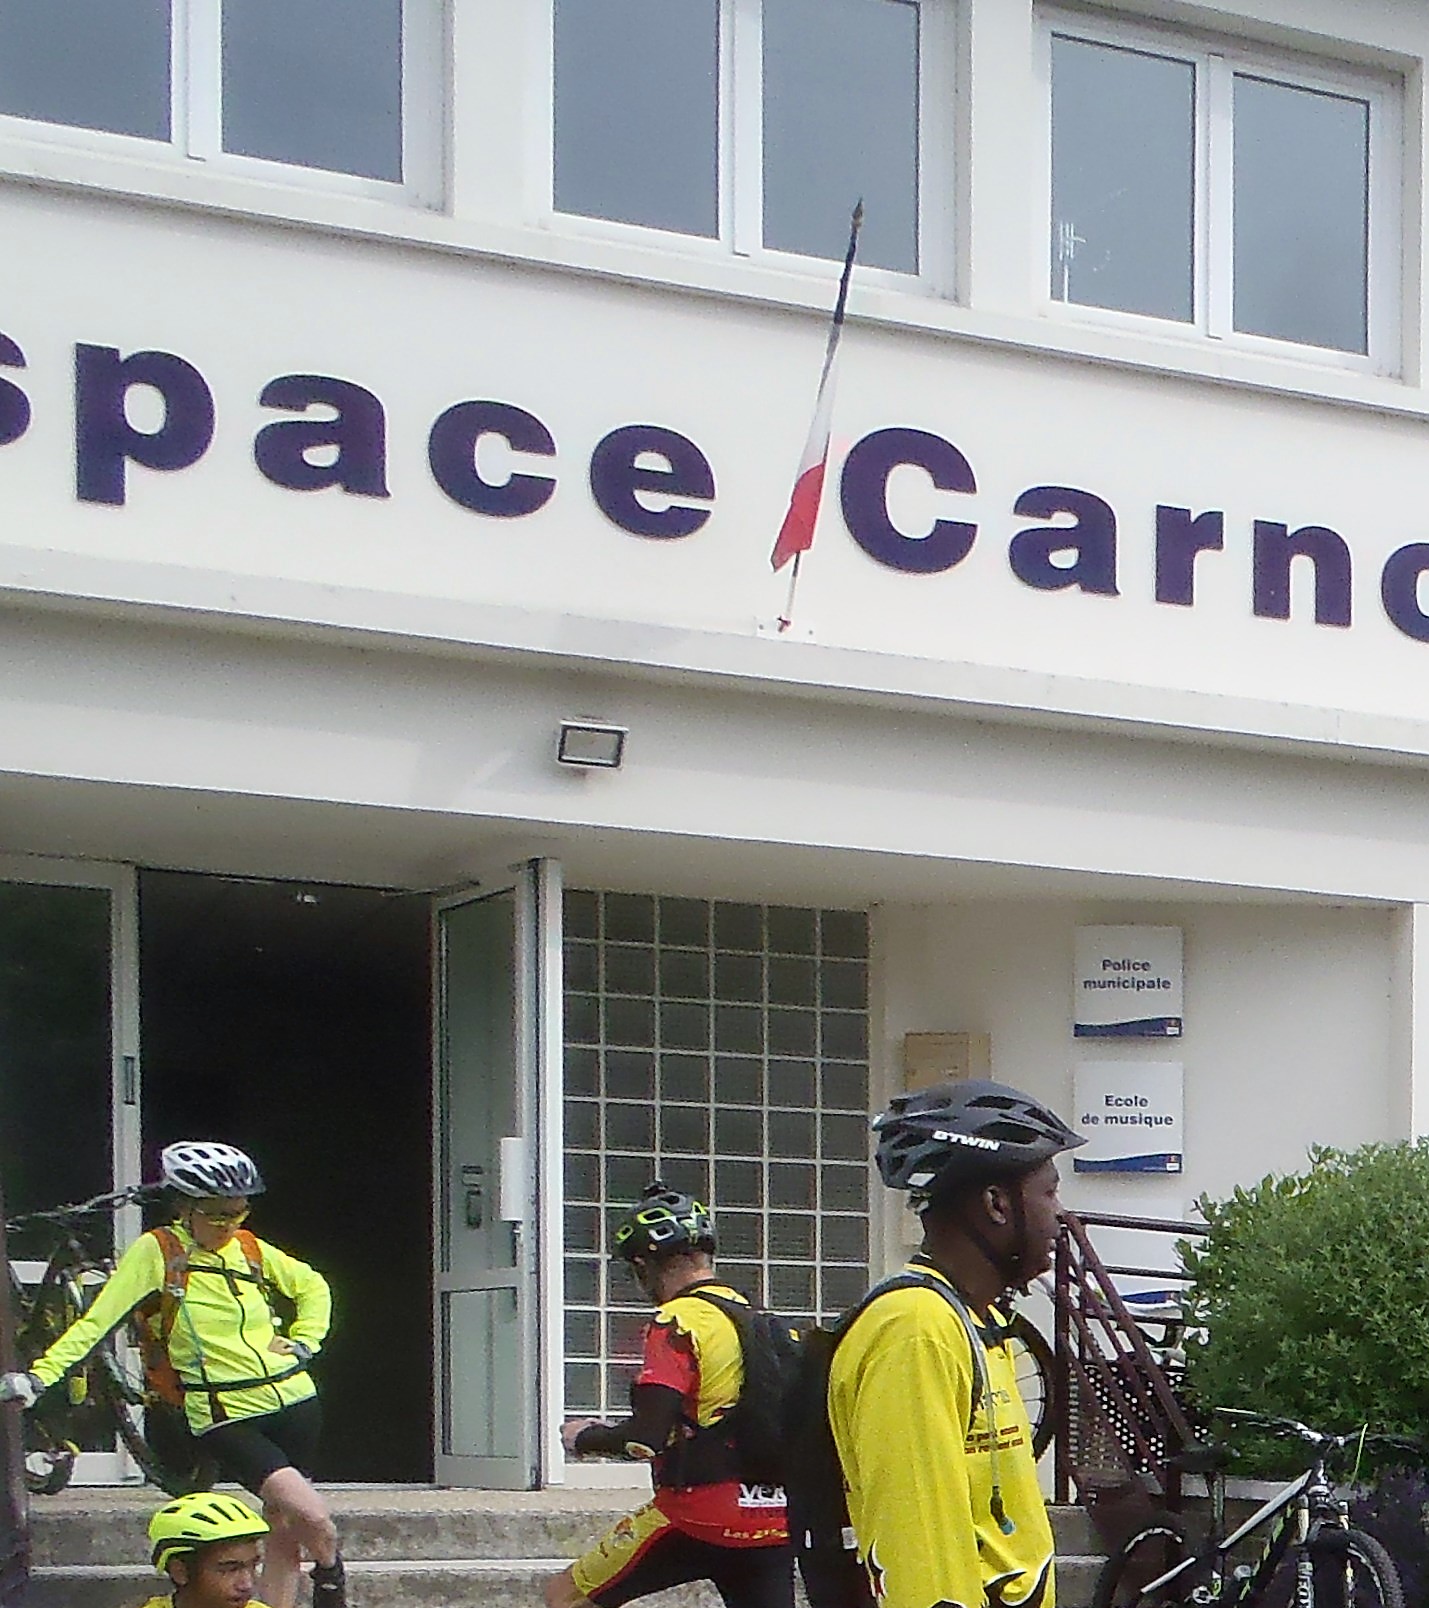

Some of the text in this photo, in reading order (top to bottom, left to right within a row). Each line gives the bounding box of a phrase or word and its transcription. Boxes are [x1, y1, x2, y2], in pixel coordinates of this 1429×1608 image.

[1102, 958, 1151, 972] Police
[1082, 976, 1172, 993] municipale
[1104, 1094, 1149, 1108] Ecole
[1081, 1112, 1174, 1128] de musique
